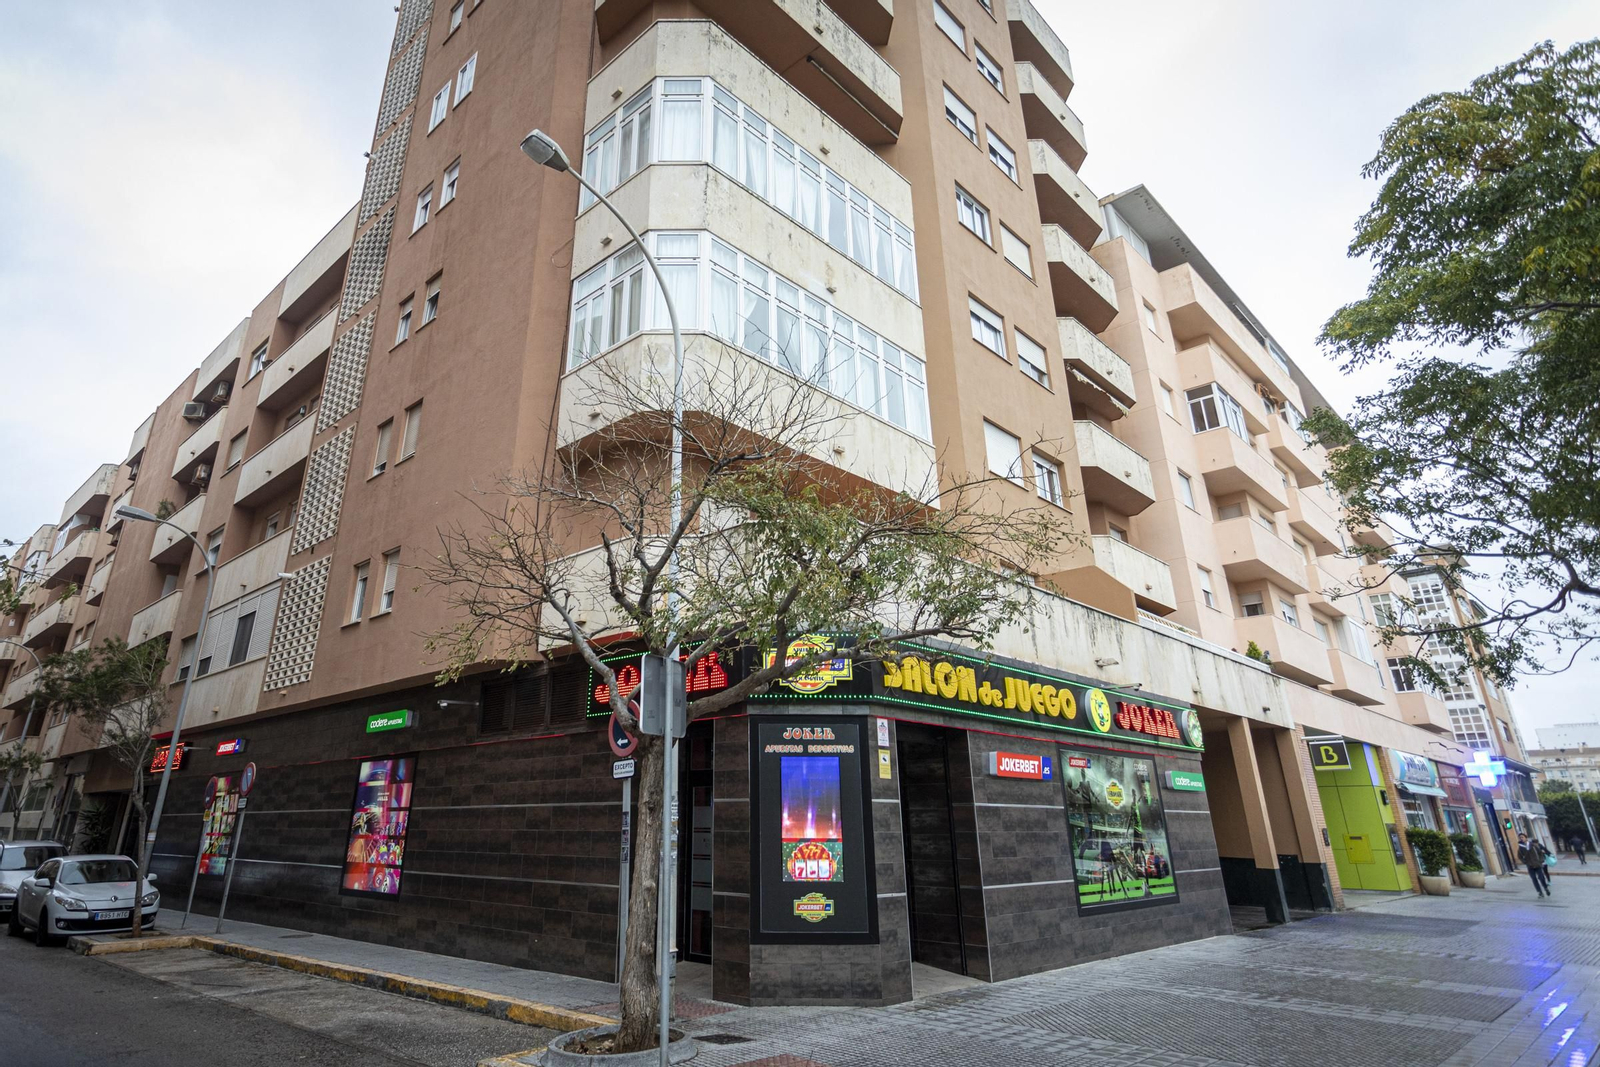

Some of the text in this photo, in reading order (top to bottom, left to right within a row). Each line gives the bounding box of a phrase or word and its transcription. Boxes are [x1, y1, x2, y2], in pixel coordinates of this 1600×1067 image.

[978, 681, 1003, 708] de
[1004, 677, 1077, 720] JUEGO
[1114, 701, 1180, 739] JOKER
[783, 727, 835, 740] JOKER
[765, 745, 854, 753] APUESTAS DEPORTIVAS
[1319, 745, 1339, 763] B
[614, 762, 633, 770] EXCEPTO
[999, 757, 1039, 774] JOKERBET
